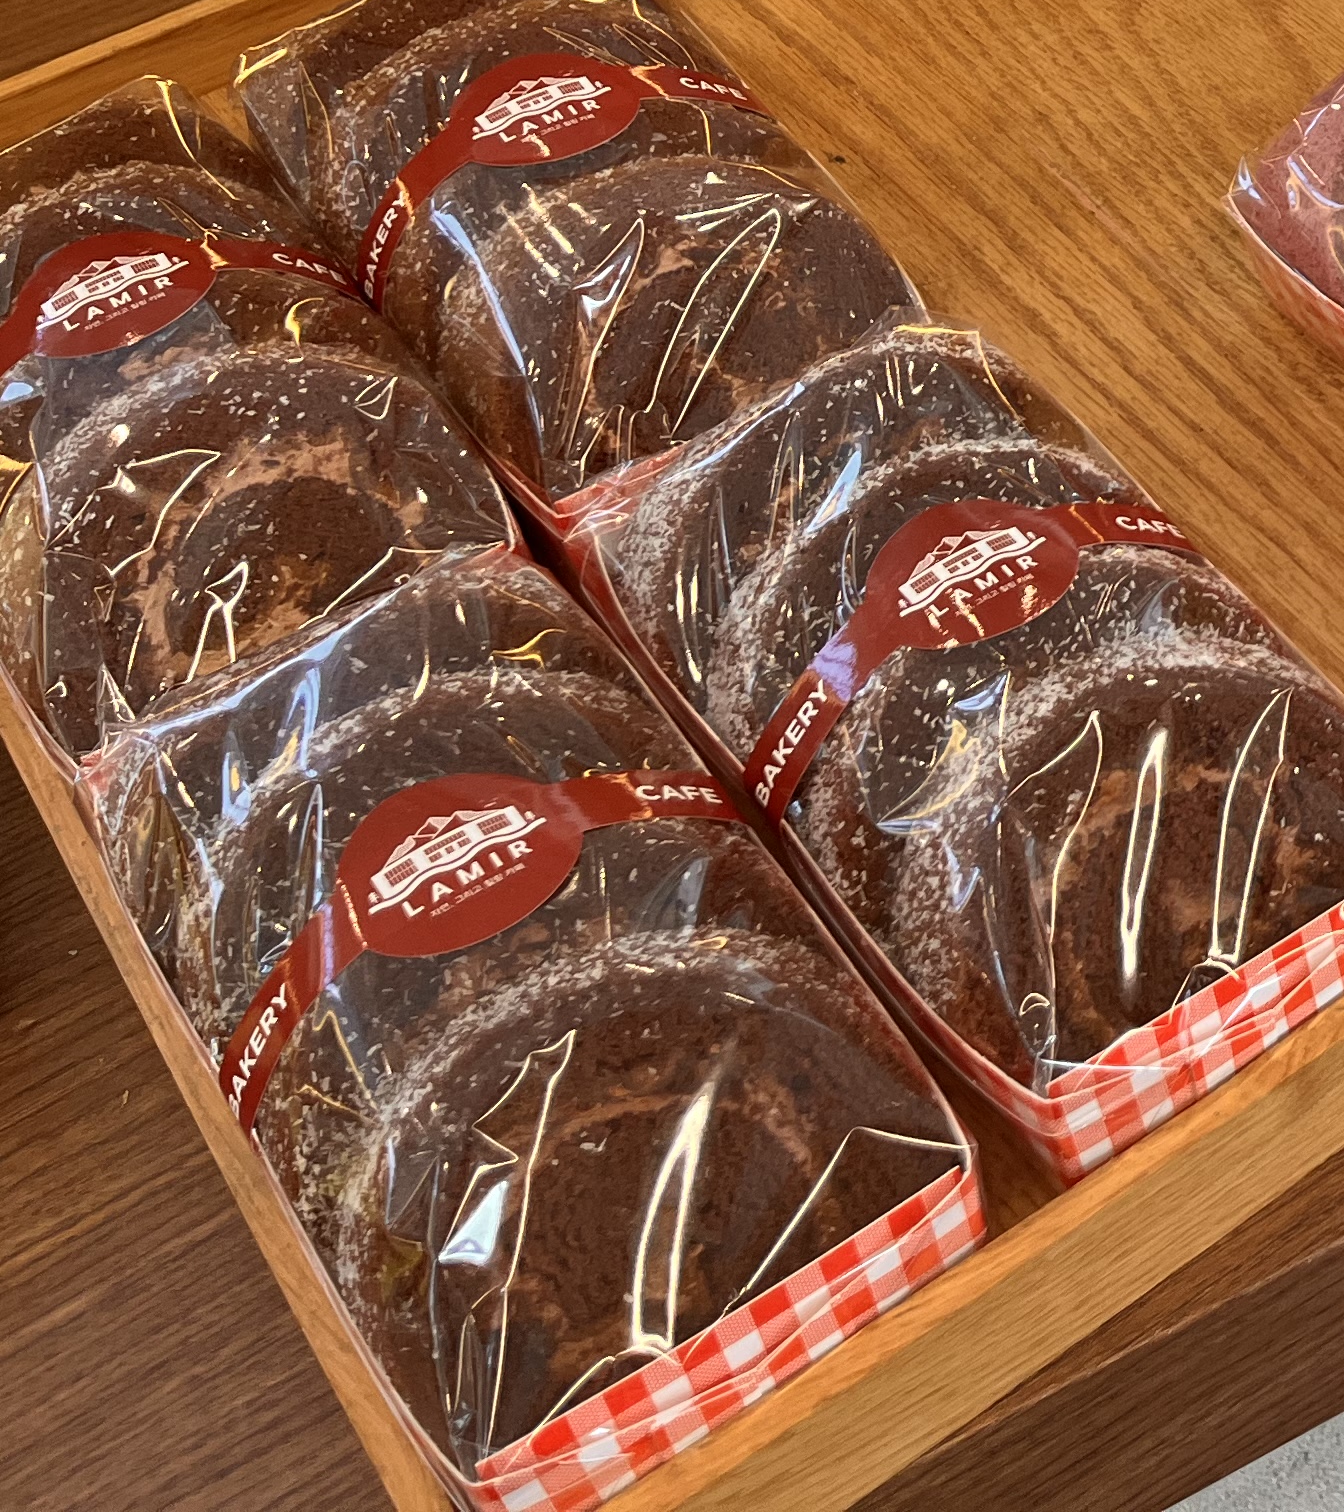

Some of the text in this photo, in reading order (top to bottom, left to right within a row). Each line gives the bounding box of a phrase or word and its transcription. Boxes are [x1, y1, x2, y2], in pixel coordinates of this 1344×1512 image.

[679, 76, 748, 101] CAFE
[498, 98, 601, 143] LAMIR
[272, 253, 347, 285] CAFE
[364, 190, 407, 299] BAKERY
[62, 275, 174, 332] LAMIR
[929, 554, 1039, 618] LAMIR
[755, 678, 828, 808] BAKERY
[635, 784, 724, 804] CAFE
[401, 839, 534, 919] LAMIR
